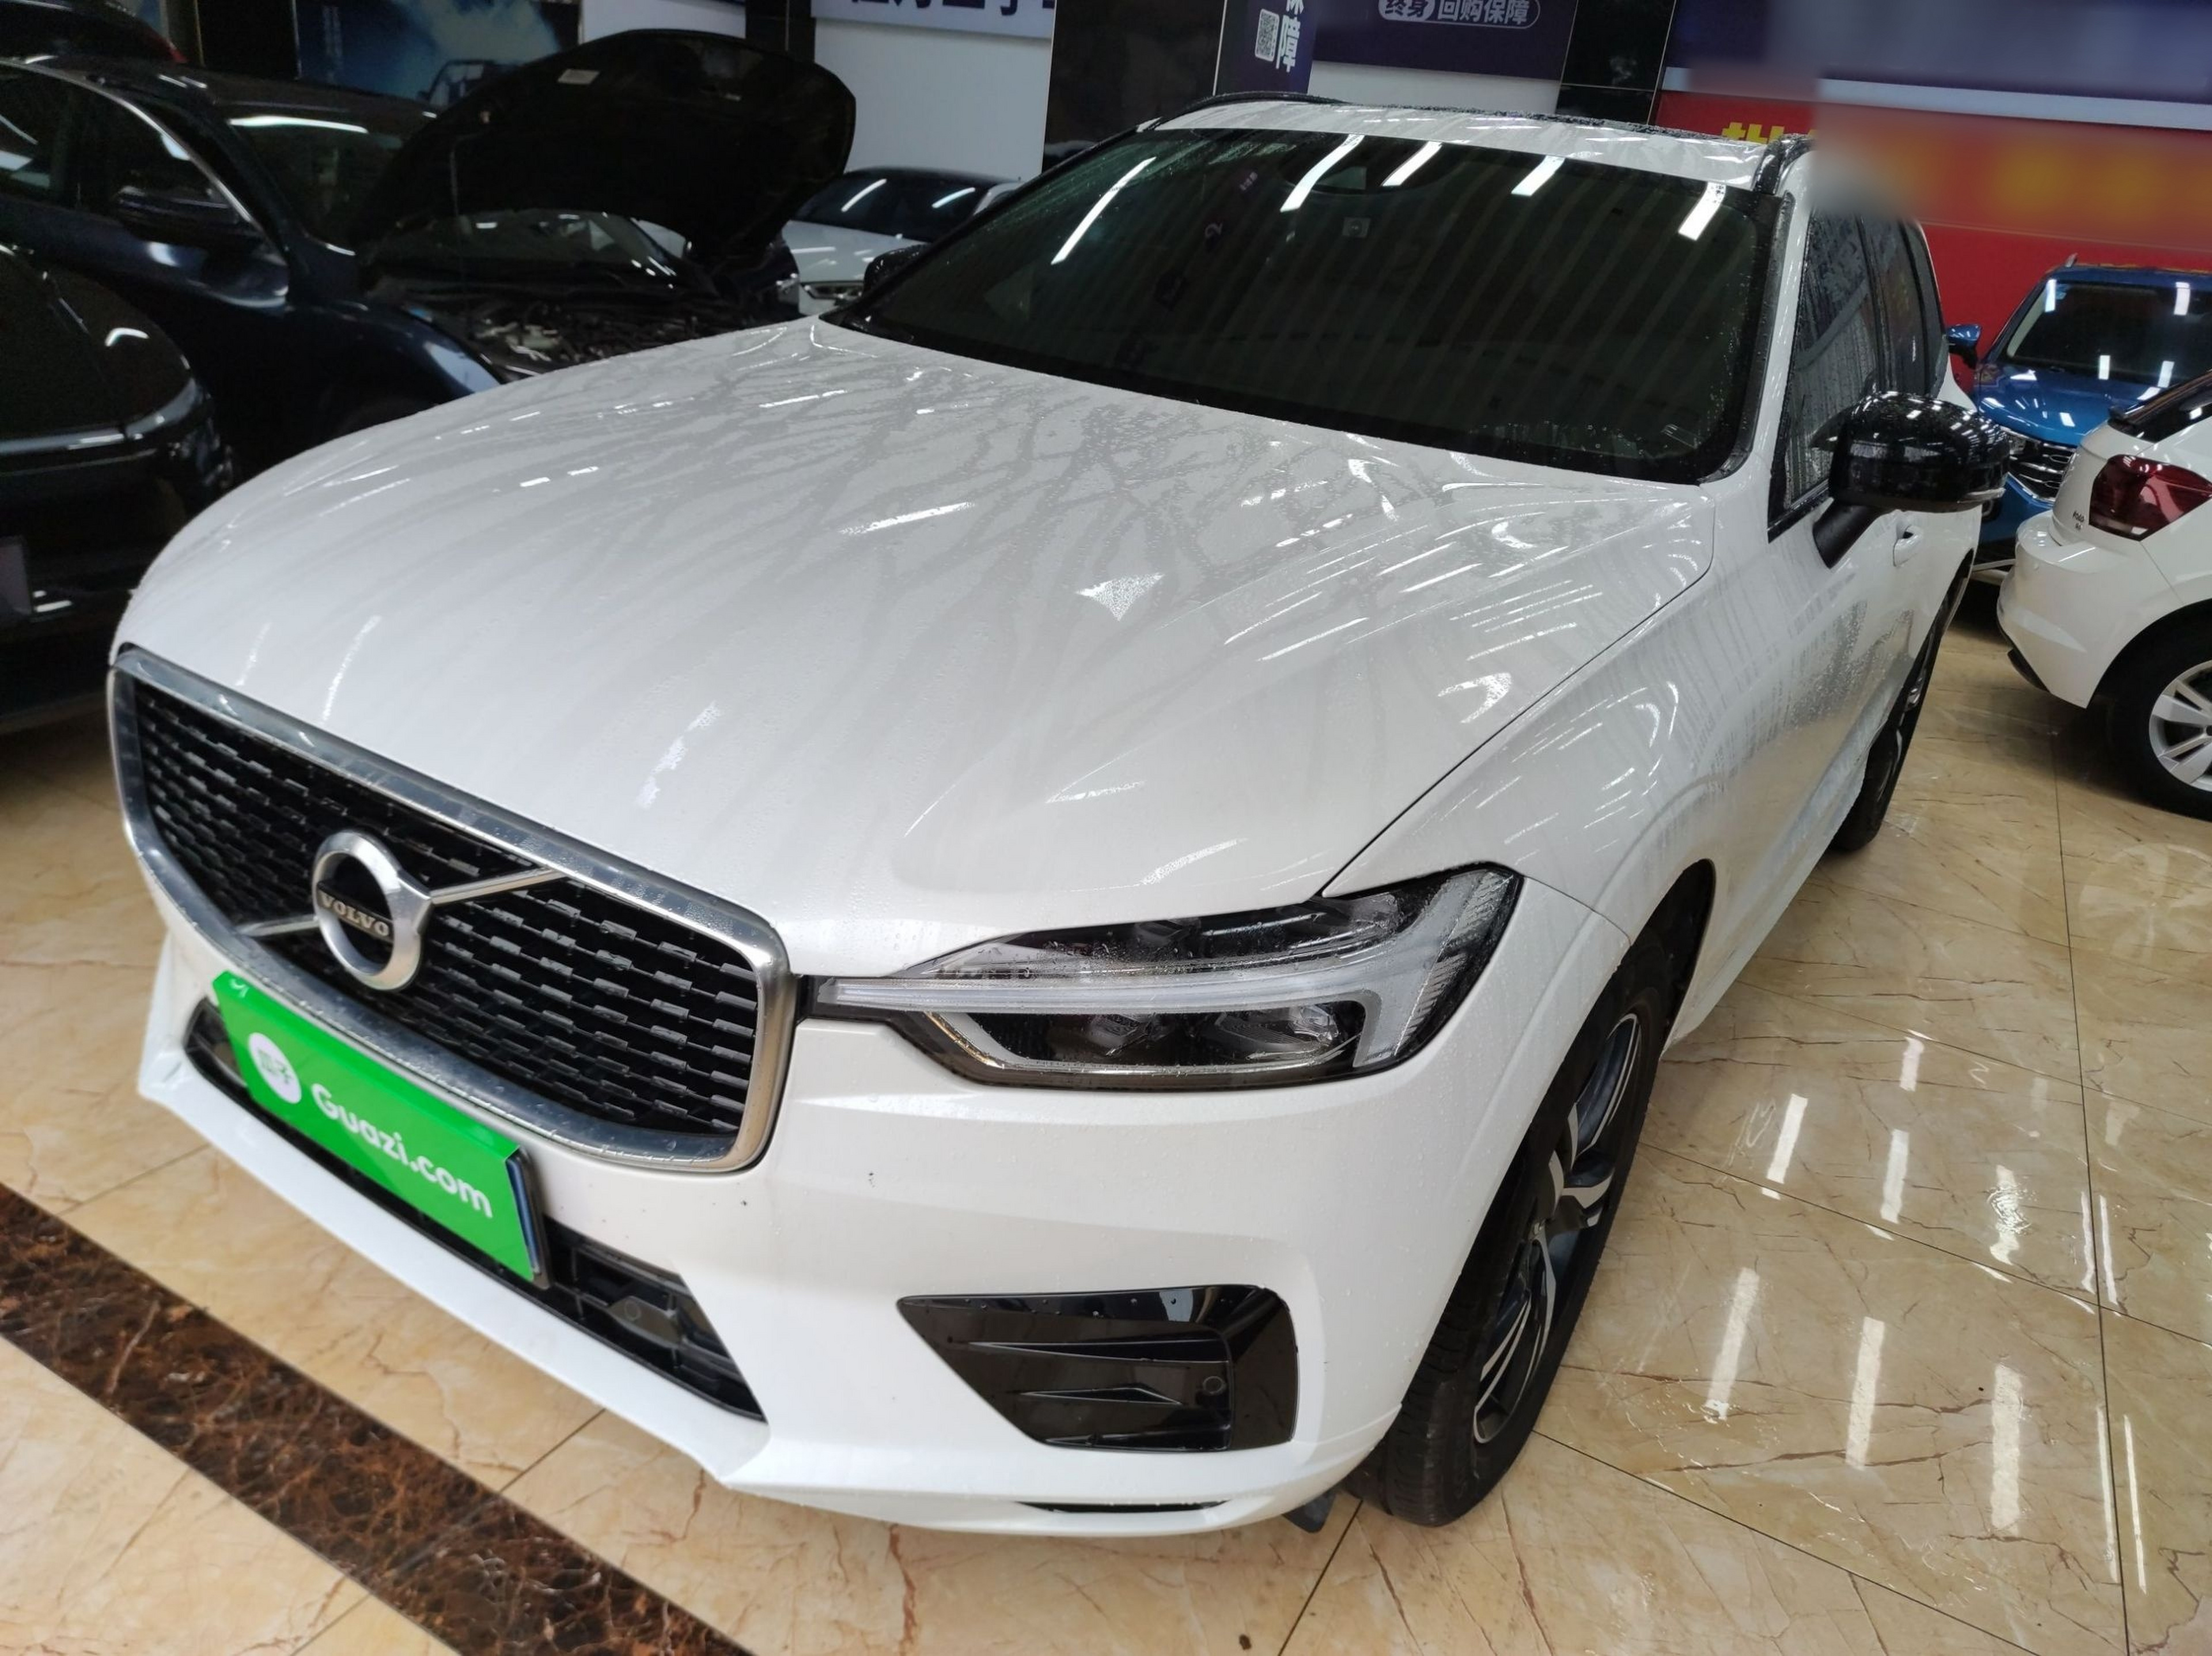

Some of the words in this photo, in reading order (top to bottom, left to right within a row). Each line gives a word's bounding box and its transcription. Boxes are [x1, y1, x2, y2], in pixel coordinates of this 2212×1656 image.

[1275, 0, 1304, 73] 障
[317, 890, 389, 937] VOLVO
[311, 1083, 493, 1219] Guazi.com
